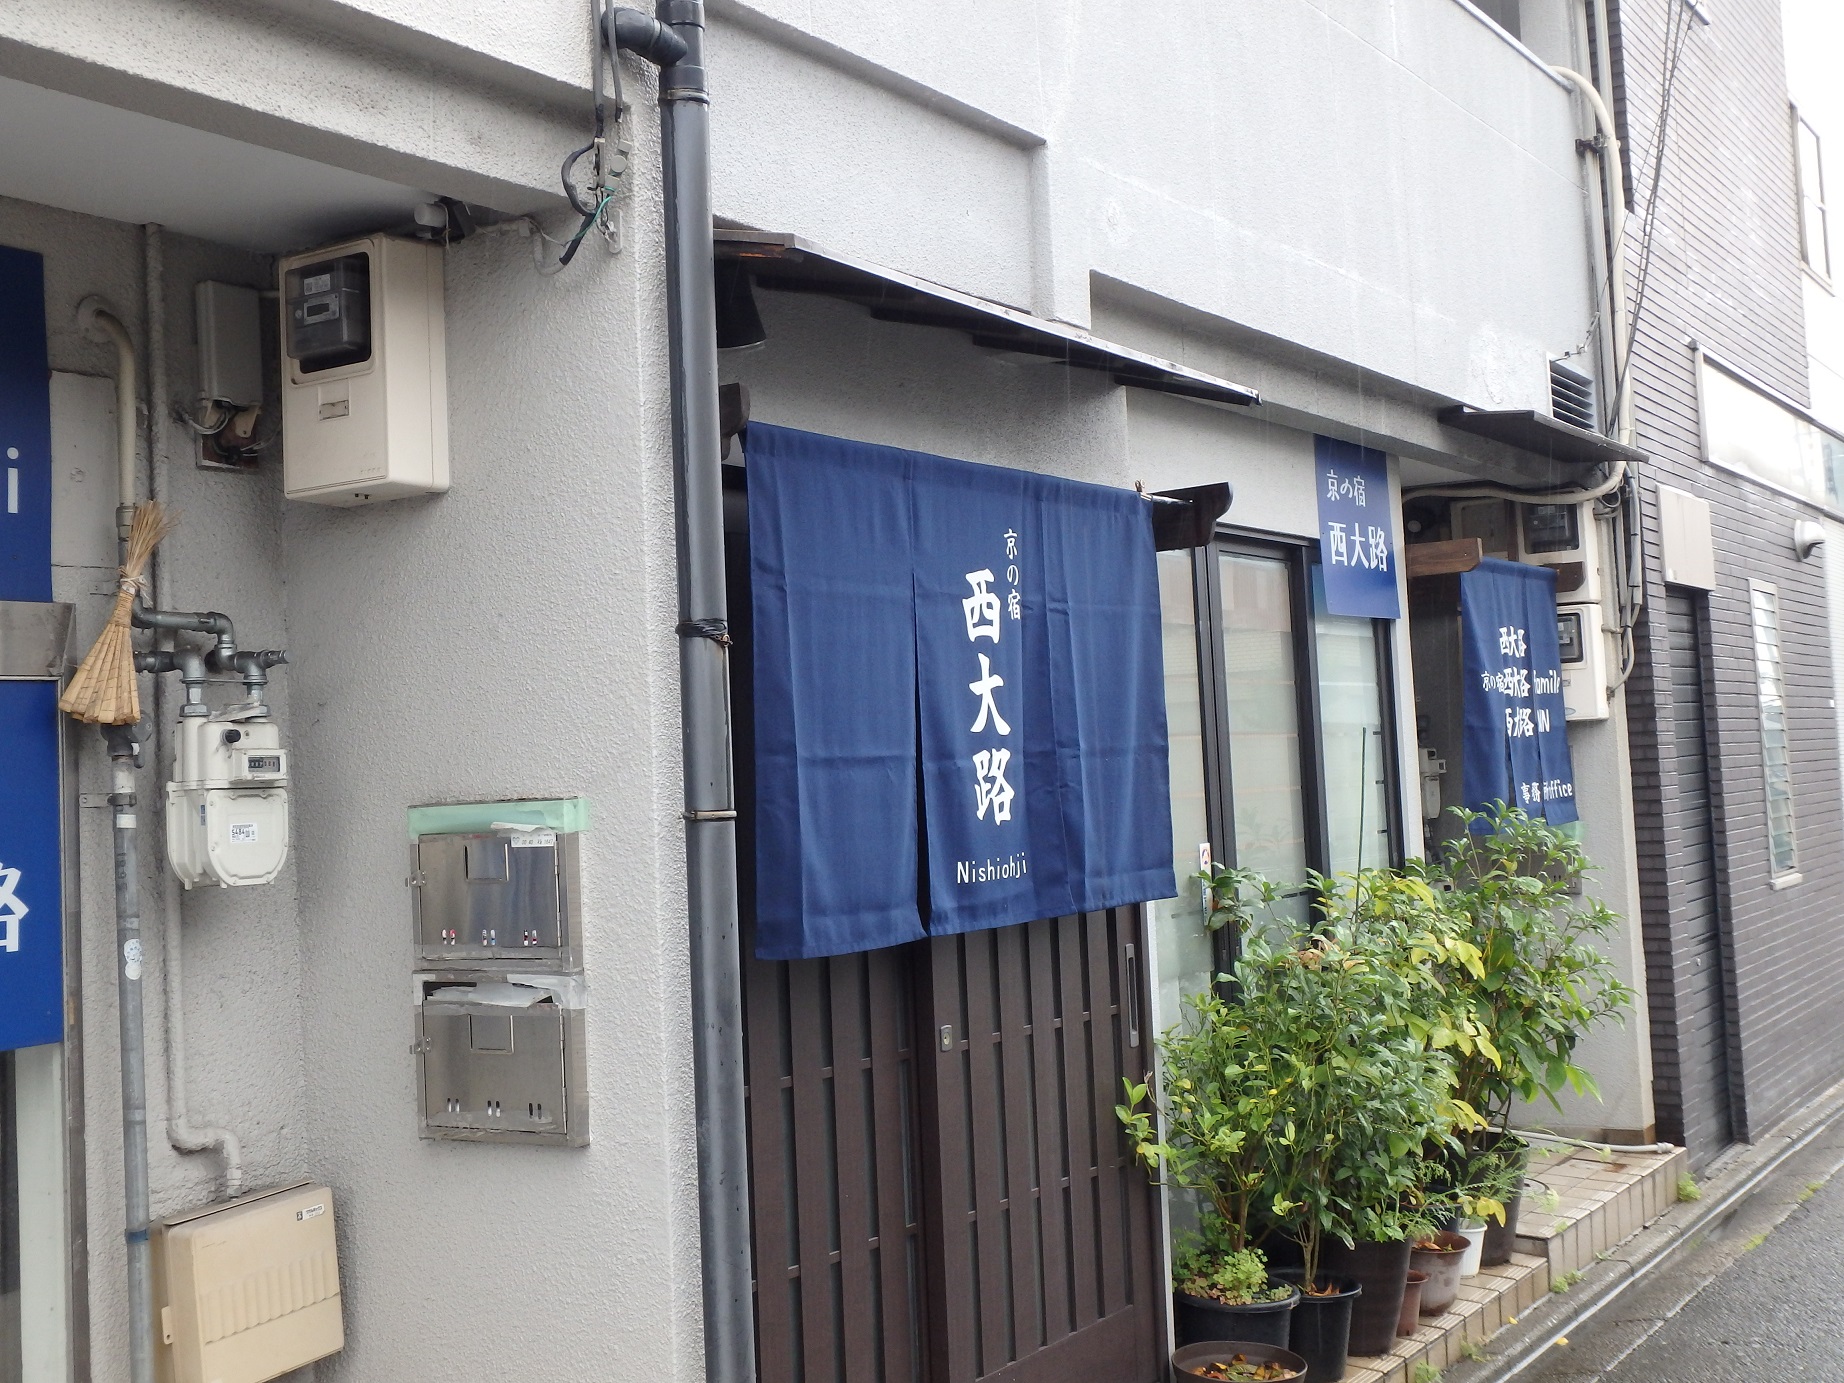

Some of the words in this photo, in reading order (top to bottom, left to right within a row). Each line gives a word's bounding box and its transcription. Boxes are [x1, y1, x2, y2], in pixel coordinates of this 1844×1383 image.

[1326, 469, 1367, 508] 京の宿
[1327, 521, 1388, 572] 西大路
[1004, 528, 1022, 620] 京の宿
[962, 568, 1015, 826] 西大路
[957, 852, 1028, 884] Nishiohji
